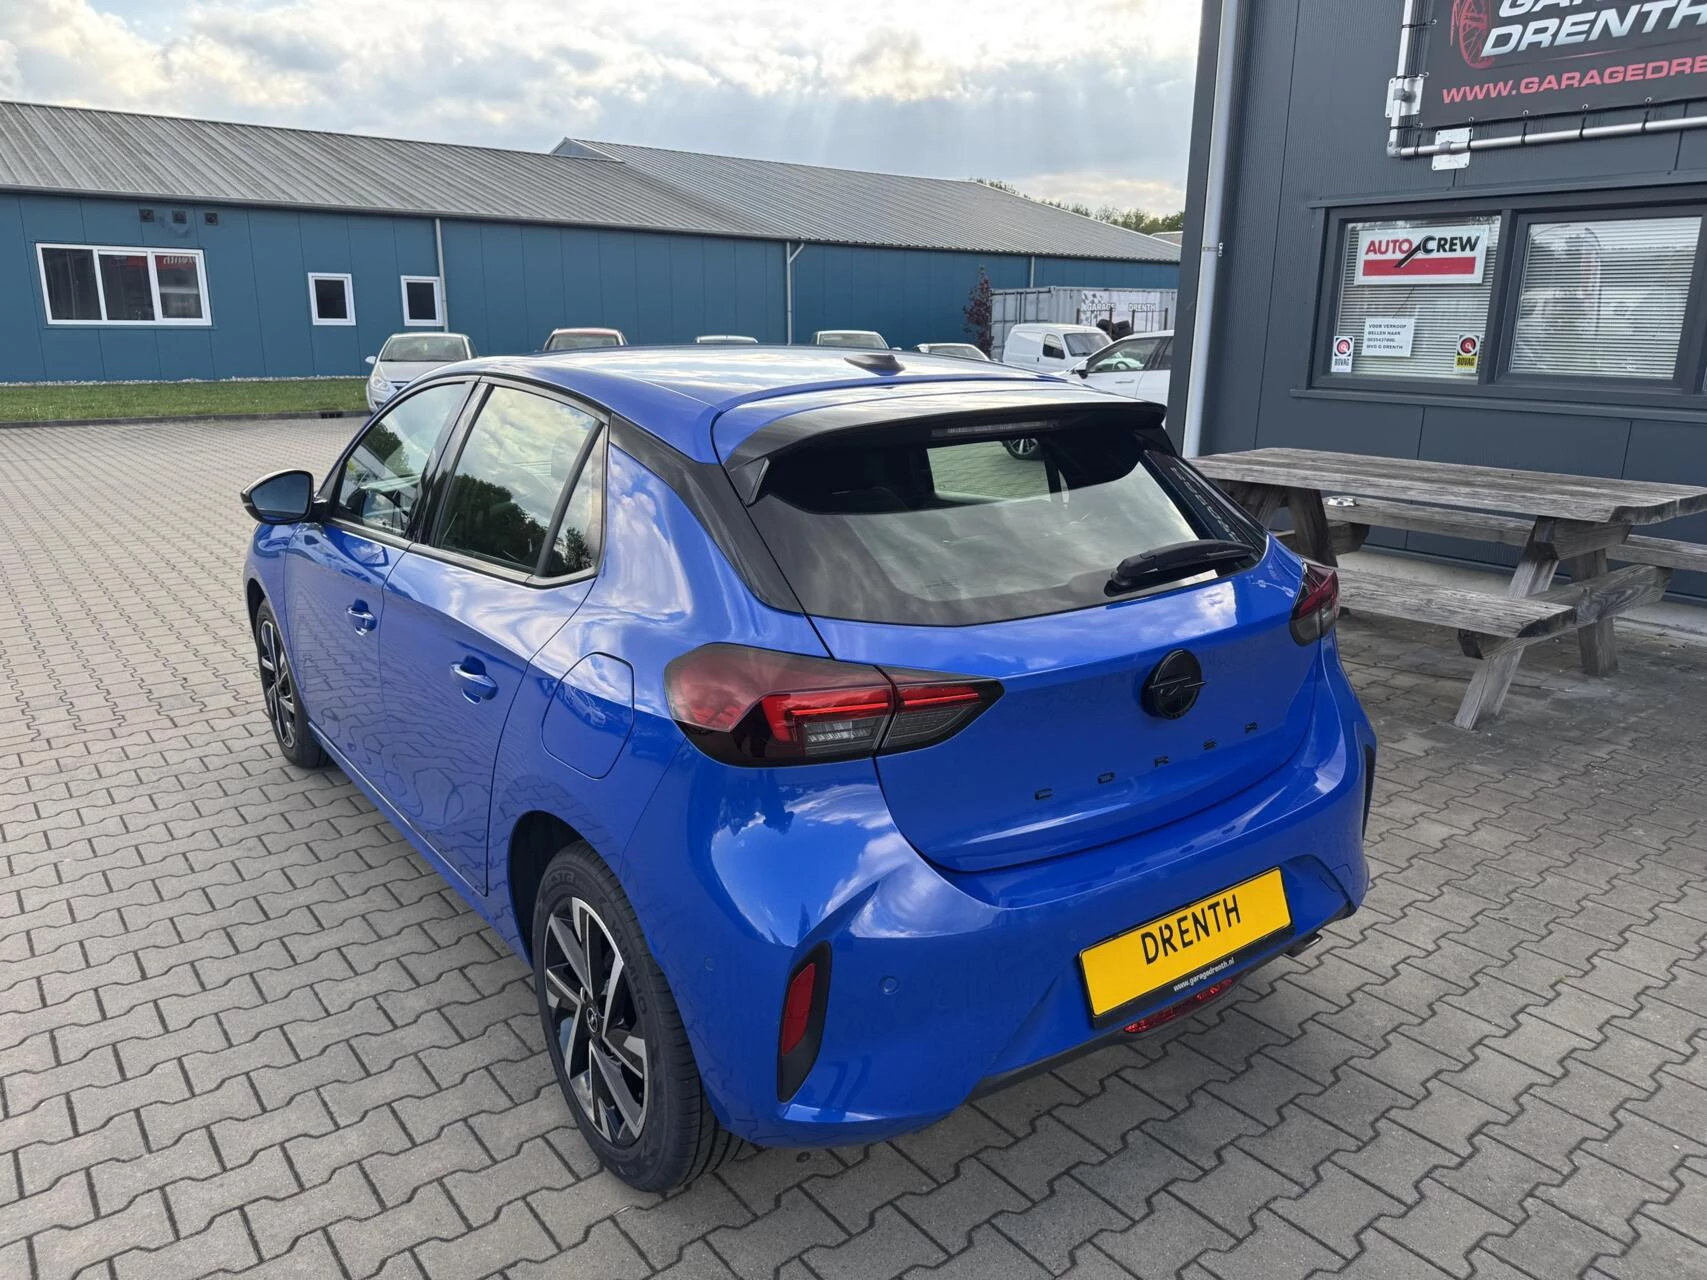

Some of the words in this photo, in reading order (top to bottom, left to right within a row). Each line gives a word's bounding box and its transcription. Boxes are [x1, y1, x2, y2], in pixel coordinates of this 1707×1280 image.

[1480, 0, 1707, 57] DRENTH
[1365, 239, 1413, 255] AUTO
[1421, 235, 1480, 254] CREW
[1457, 357, 1475, 366] BOVAG
[1034, 721, 1258, 801] CORSA
[1140, 894, 1241, 965] DRENTH
[1173, 957, 1235, 991] www.garagedrenth.nl
